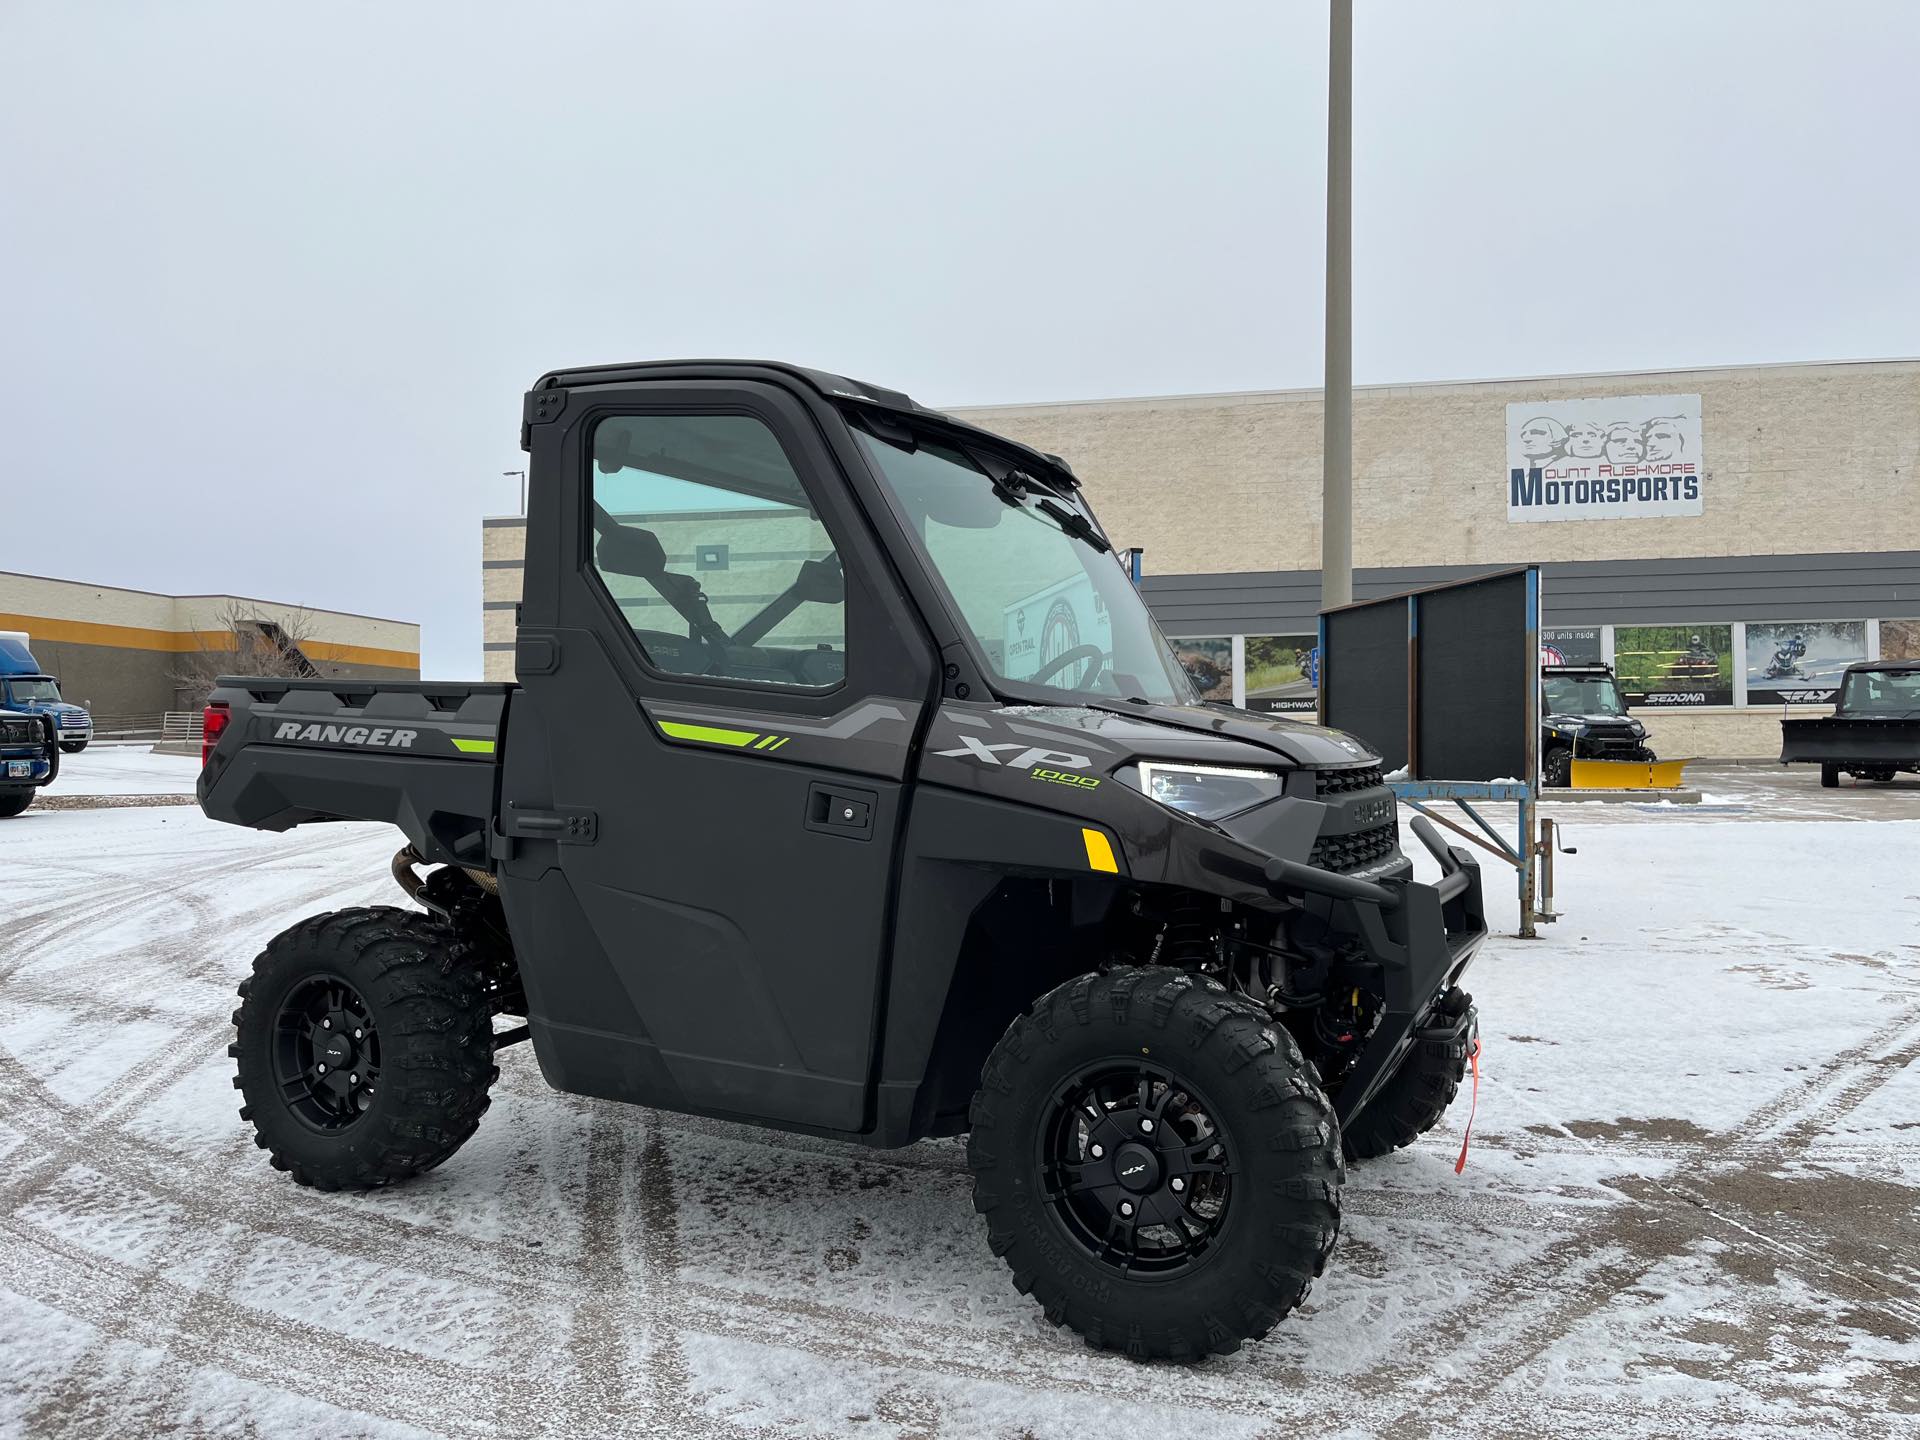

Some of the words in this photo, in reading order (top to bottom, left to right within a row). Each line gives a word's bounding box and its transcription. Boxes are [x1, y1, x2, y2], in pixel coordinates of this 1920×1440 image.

[1598, 463, 1696, 478] RUSHMORE
[1511, 468, 1698, 506] MOTORSPORTS
[1645, 692, 1705, 703] SEDONA
[1777, 690, 1836, 701] FLY
[1271, 701, 1314, 709] HIGHWAY
[274, 722, 418, 748] RANGER
[930, 735, 1093, 770] XP
[1032, 767, 1101, 788] 1000
[1121, 1164, 1146, 1176] XP
